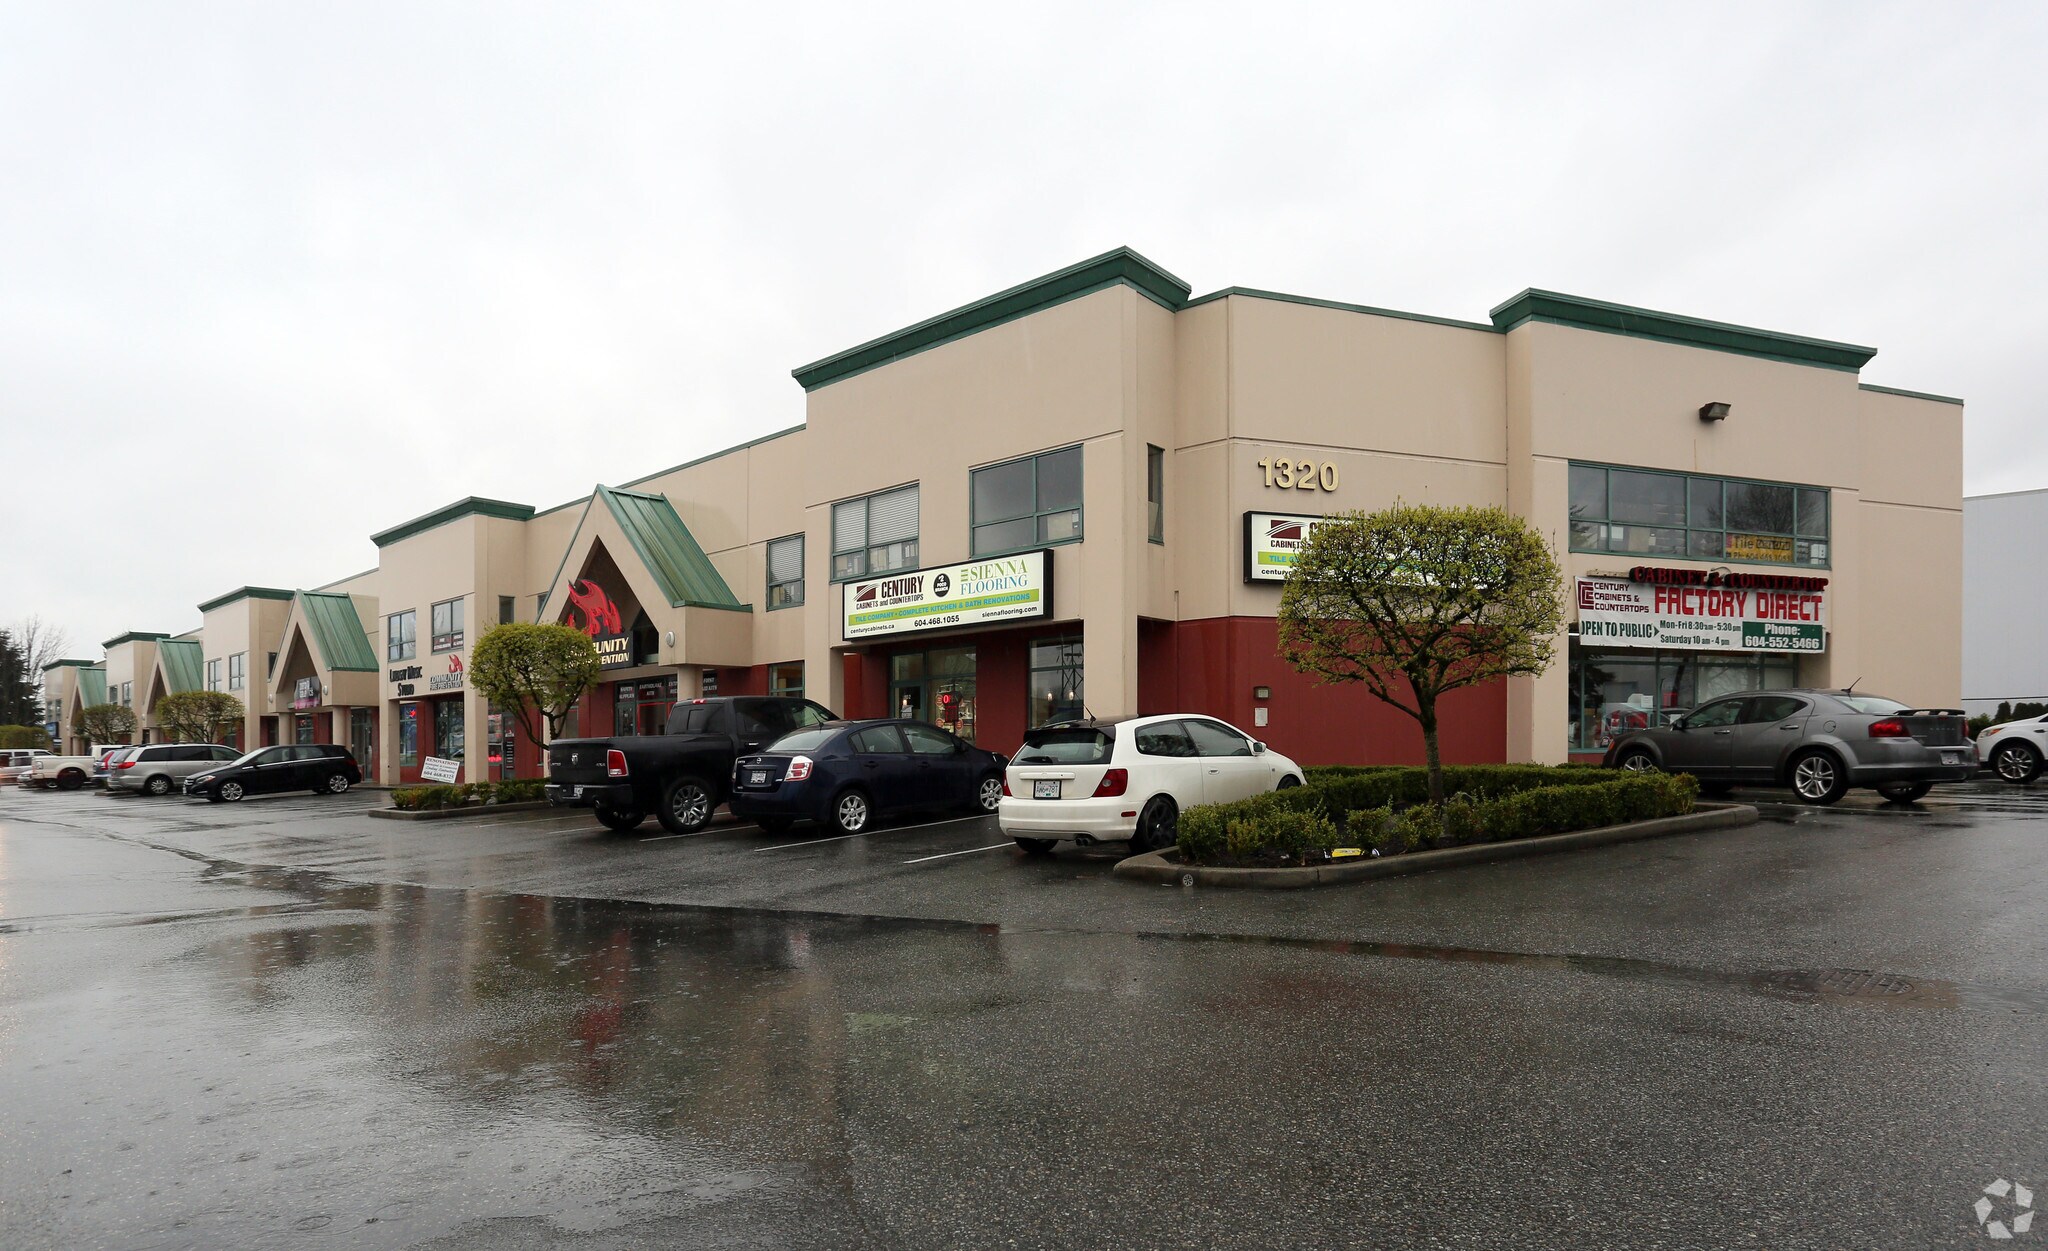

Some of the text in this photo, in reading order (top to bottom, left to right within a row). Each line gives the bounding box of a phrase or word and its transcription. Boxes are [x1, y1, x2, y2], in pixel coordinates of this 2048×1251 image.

[1258, 457, 1339, 493] 1320
[1271, 540, 1302, 549] CABINET
[1269, 555, 1287, 563] TILE
[970, 559, 1028, 581] SIENNA
[961, 574, 1028, 595] FLOORING
[1631, 566, 1829, 591] CABINET & COUNTERTOP
[881, 575, 924, 598] CENTURY
[1594, 582, 1630, 591] CENTURY
[856, 600, 878, 610] CABINETS
[889, 594, 924, 605] COUNTERTOPS
[1594, 592, 1632, 602] CABINETS
[868, 612, 894, 621] COMPANY
[898, 607, 929, 616] COMPLETE
[930, 602, 957, 612] KITCHEN
[965, 599, 982, 608] BATH
[984, 593, 1030, 605] RENOVATIONS
[1594, 603, 1650, 613] COUNTERTOPS
[1654, 586, 1823, 621] FACTORY DIRECT
[982, 606, 1038, 618] siennaflooring.com
[914, 615, 960, 627] 604.468.1055
[850, 624, 895, 634] centurycabinets.ca
[1605, 621, 1617, 637] TO
[1619, 622, 1652, 638] PUBLIC
[1764, 624, 1801, 635] Phone:
[593, 637, 629, 654] UNITY
[1660, 634, 1692, 645] Saturday
[1693, 636, 1700, 644] 10
[1715, 637, 1720, 645] 4
[1745, 636, 1820, 649] 604-552-5466
[430, 672, 463, 684] COMMUNITY
[426, 758, 458, 766] RENOVATIONS
